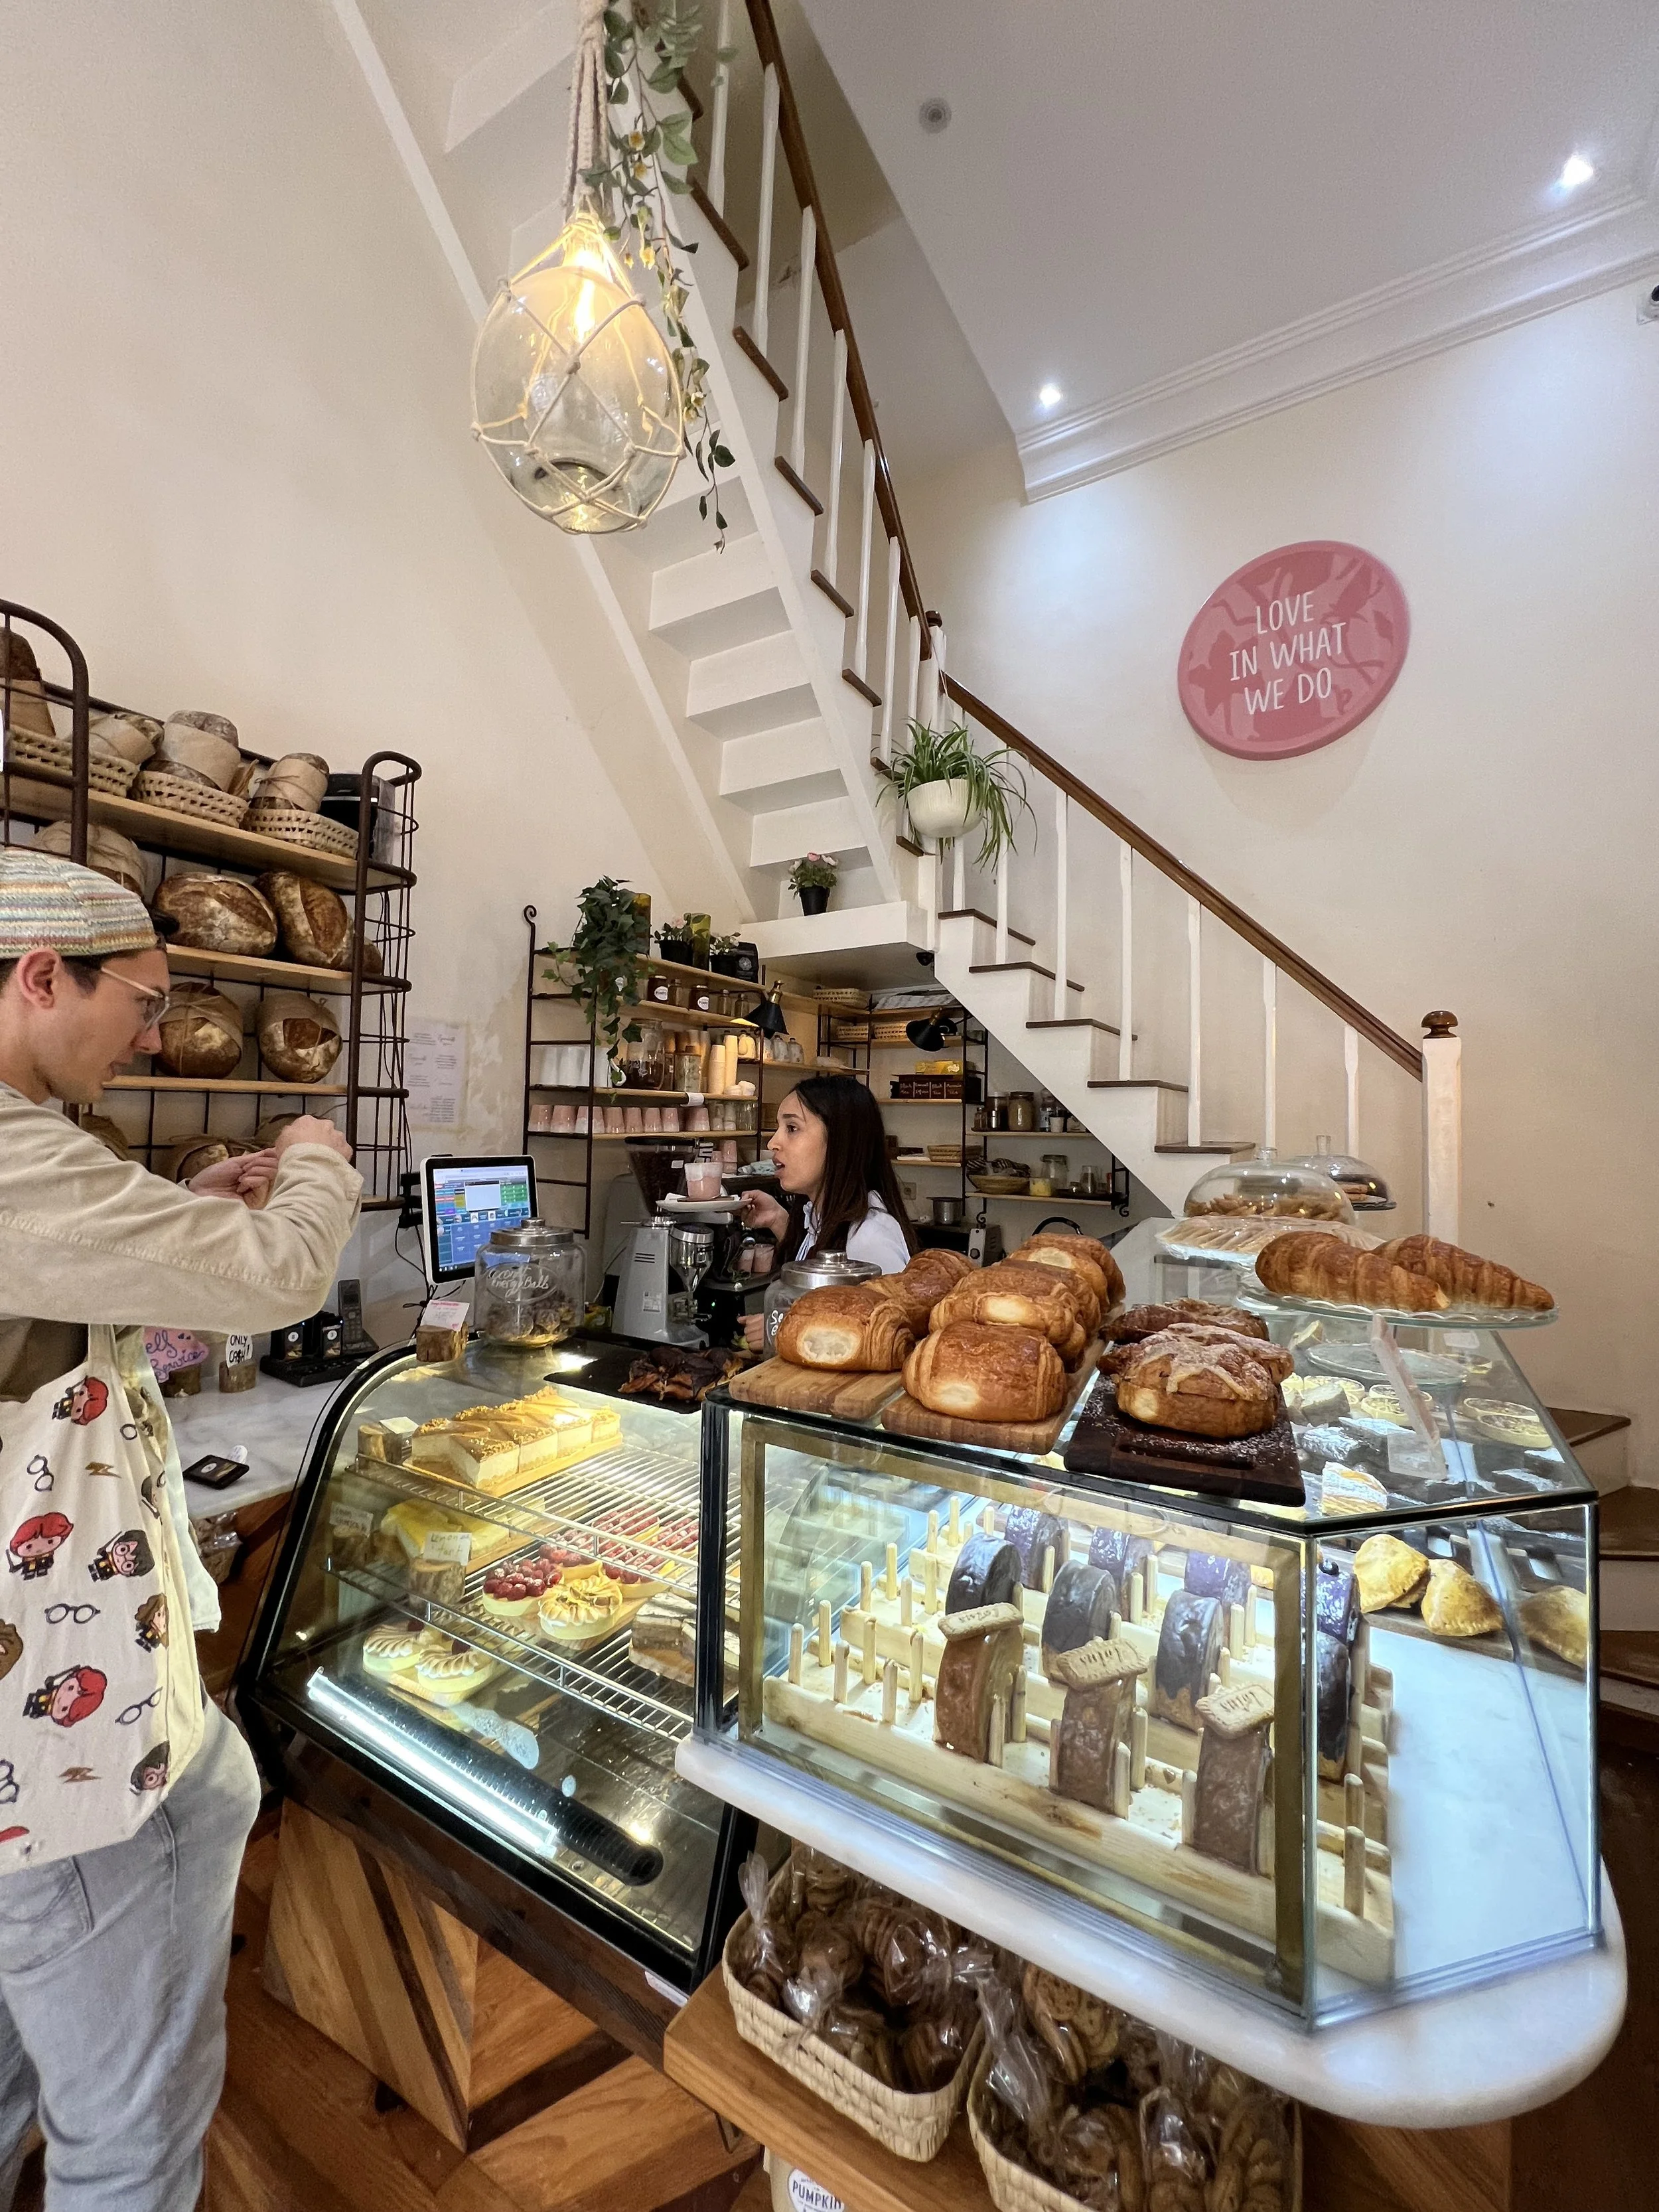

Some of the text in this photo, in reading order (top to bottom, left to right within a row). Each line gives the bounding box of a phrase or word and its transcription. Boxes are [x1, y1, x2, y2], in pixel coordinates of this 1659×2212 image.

[1256, 590, 1316, 635] LOVE
[1228, 622, 1347, 682] IN WHAT
[1244, 667, 1333, 715] WE DO
[145, 1329, 178, 1359] elf
[230, 1334, 248, 1348] ONLY
[792, 2179, 841, 2210] PUMPKIN
